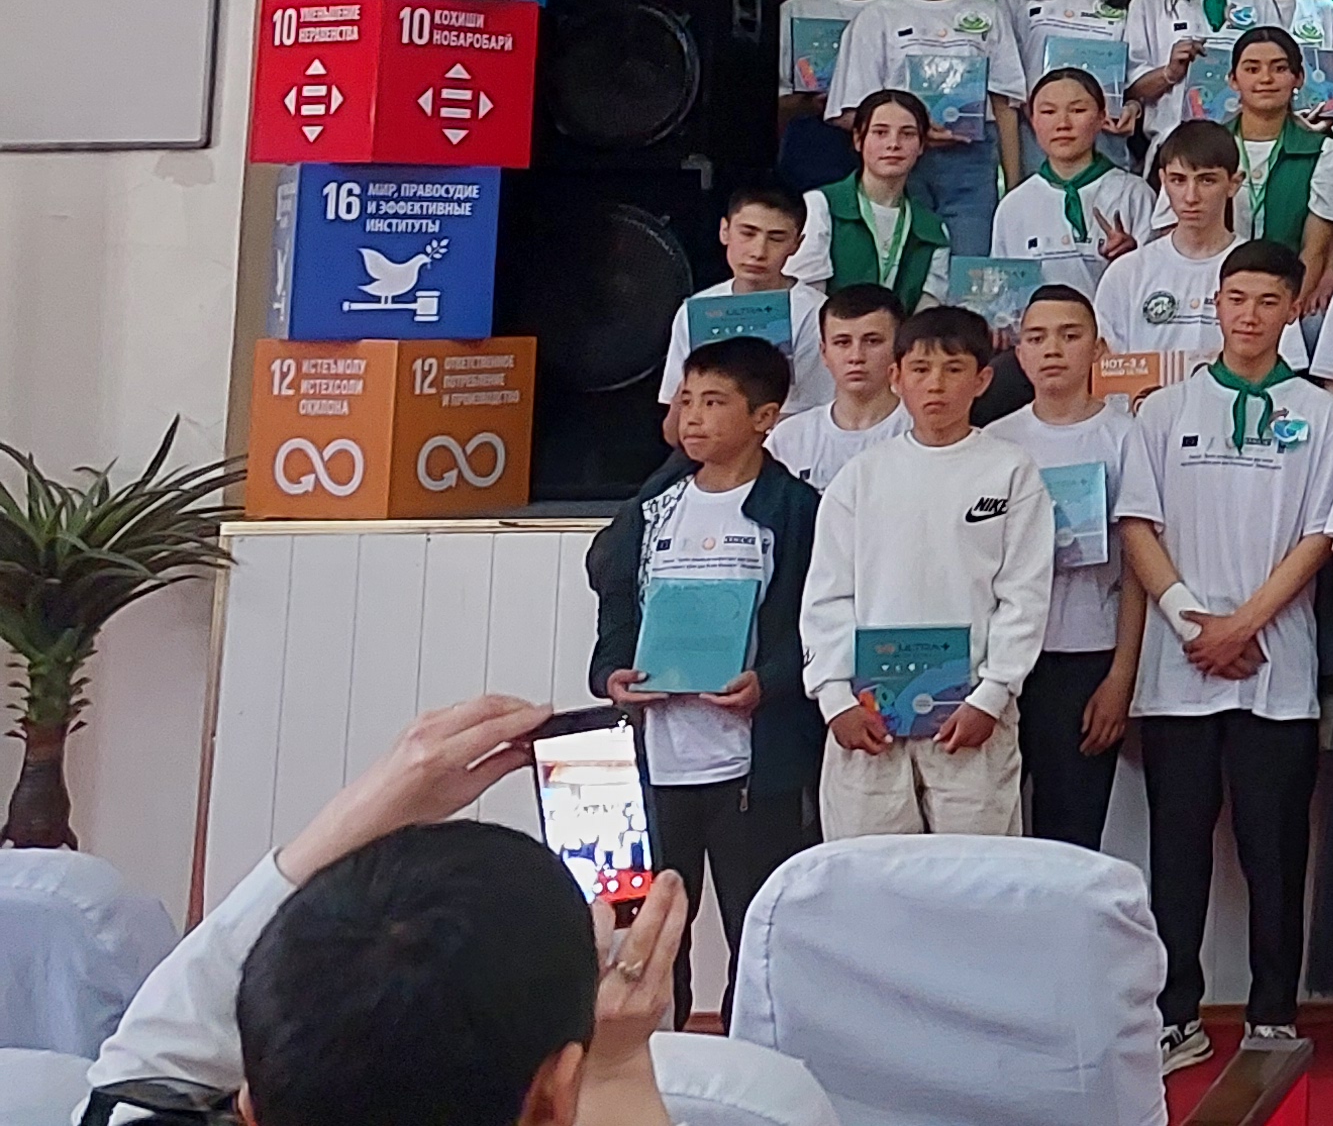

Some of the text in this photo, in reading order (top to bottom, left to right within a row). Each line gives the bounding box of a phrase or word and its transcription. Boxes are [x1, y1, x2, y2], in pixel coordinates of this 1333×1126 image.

[273, 7, 298, 47] 10
[400, 6, 431, 46] 10
[323, 182, 362, 221] 16
[368, 200, 473, 216] И ЭФФЕКТИВНЫЕ
[401, 183, 480, 201] ПРАВОСУДИЕ
[366, 218, 441, 234] ИНСТИТУТЫ
[271, 358, 297, 396] 12
[413, 357, 438, 395] 12
[973, 496, 1008, 513] NIKE
